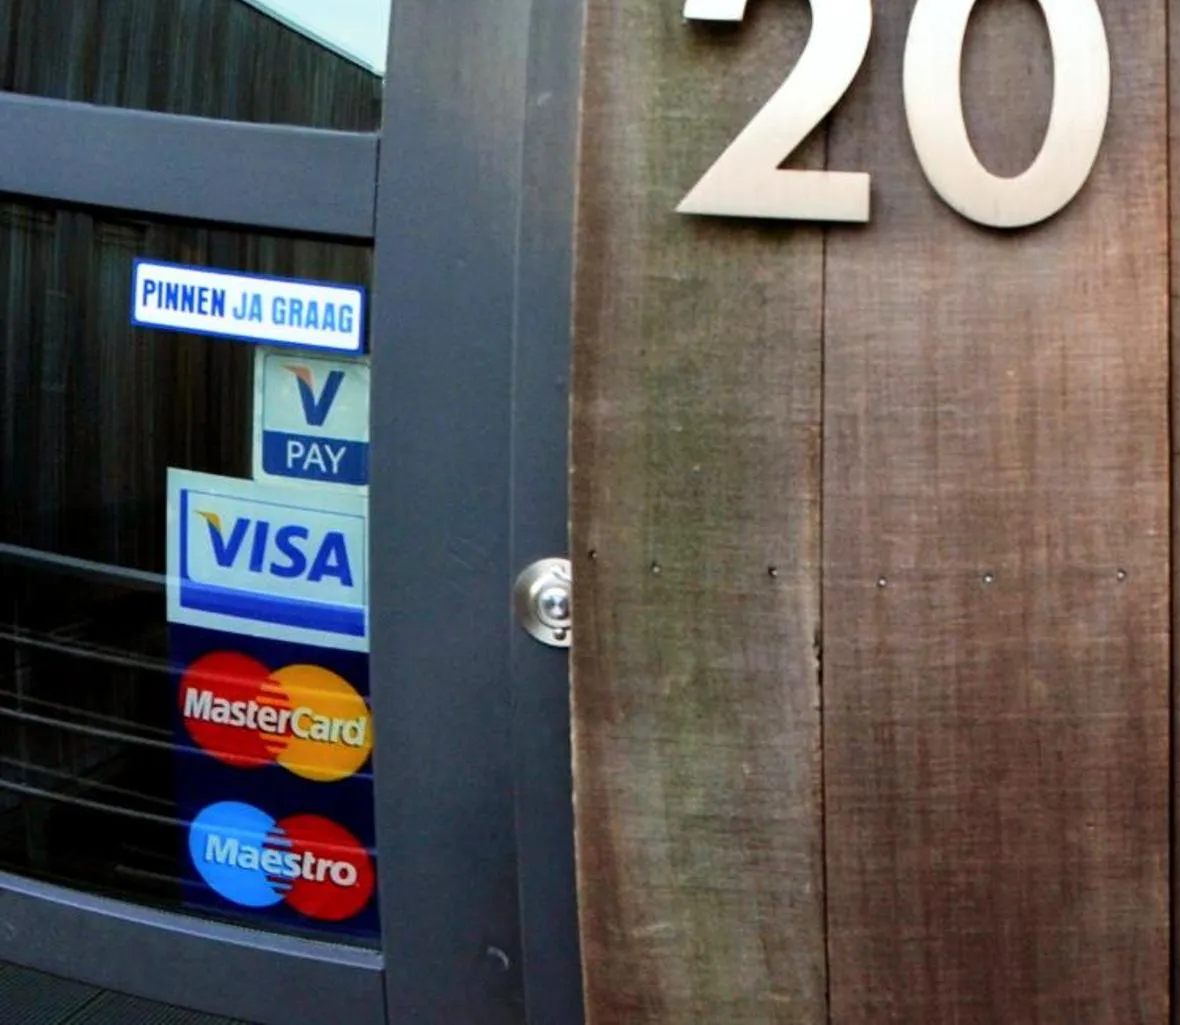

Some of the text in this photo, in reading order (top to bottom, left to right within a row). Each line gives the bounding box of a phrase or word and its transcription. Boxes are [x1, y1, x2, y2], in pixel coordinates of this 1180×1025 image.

[142, 279, 354, 333] PINNEN JA GRAAG
[283, 364, 345, 426] V
[286, 440, 347, 474] PAY
[194, 510, 354, 587] VISA
[183, 687, 368, 746] MasterCard
[204, 834, 358, 887] Maestro
